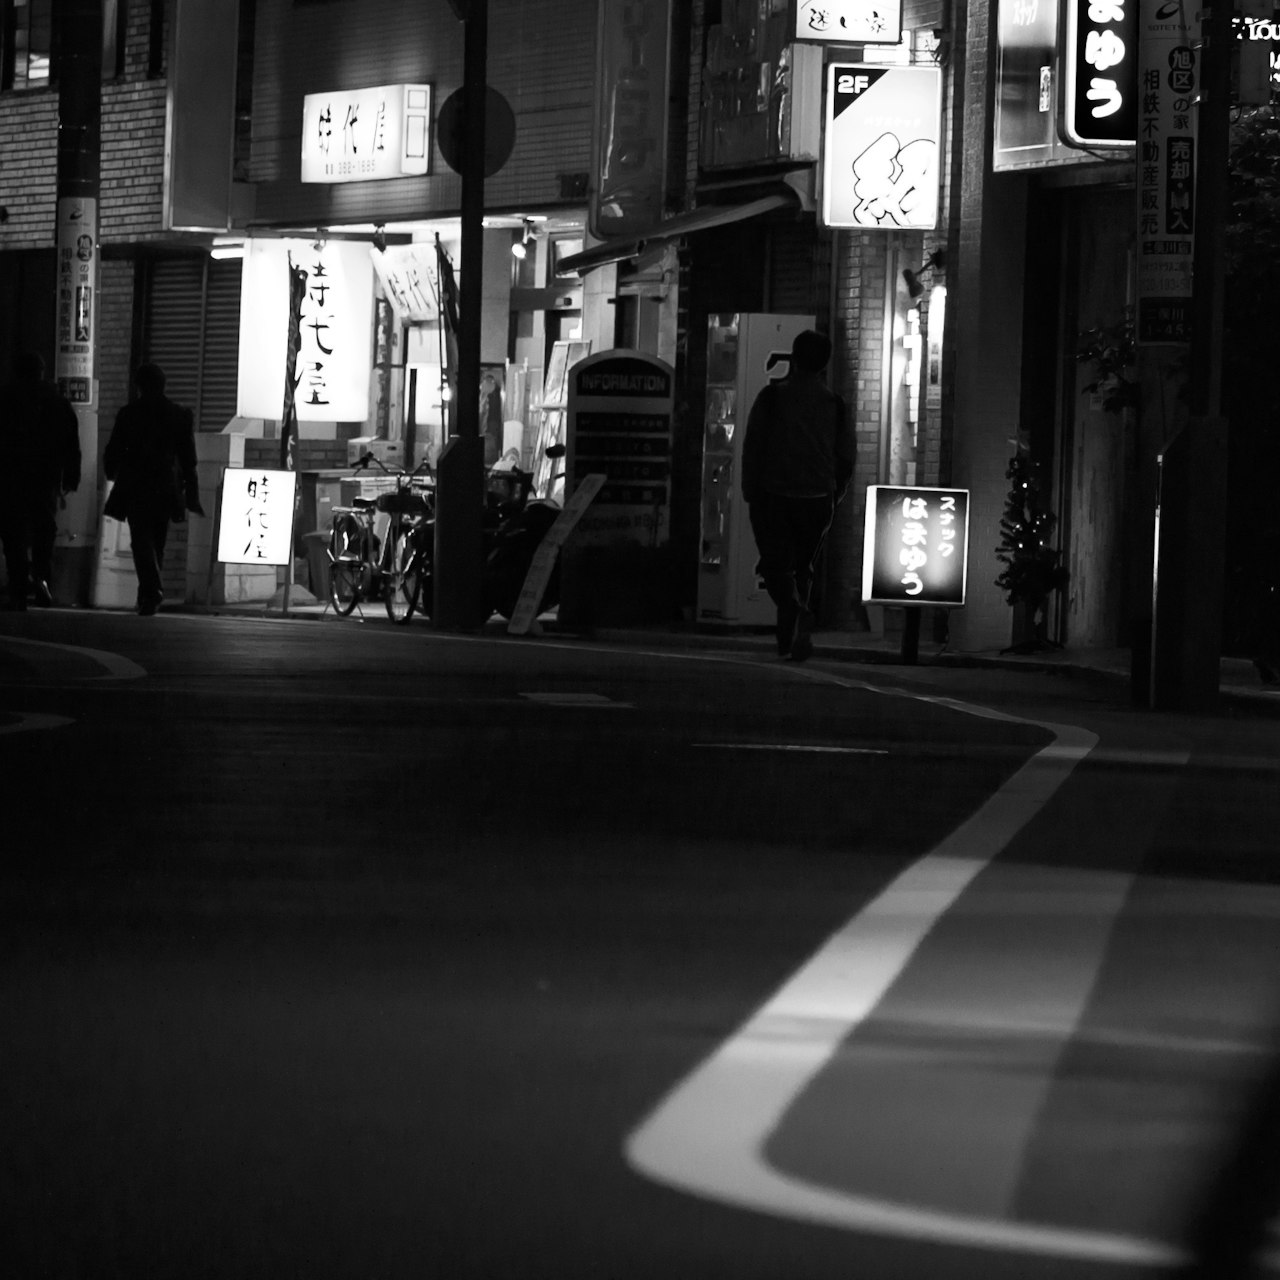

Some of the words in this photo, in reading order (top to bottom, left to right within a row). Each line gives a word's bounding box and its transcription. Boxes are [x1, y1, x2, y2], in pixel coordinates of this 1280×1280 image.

[837, 74, 869, 95] 2F
[1141, 69, 1160, 236] 相鉄不動産販売
[581, 374, 666, 392] INFORMATION
[898, 496, 929, 596] はまゆう
[936, 496, 957, 558] スナック
